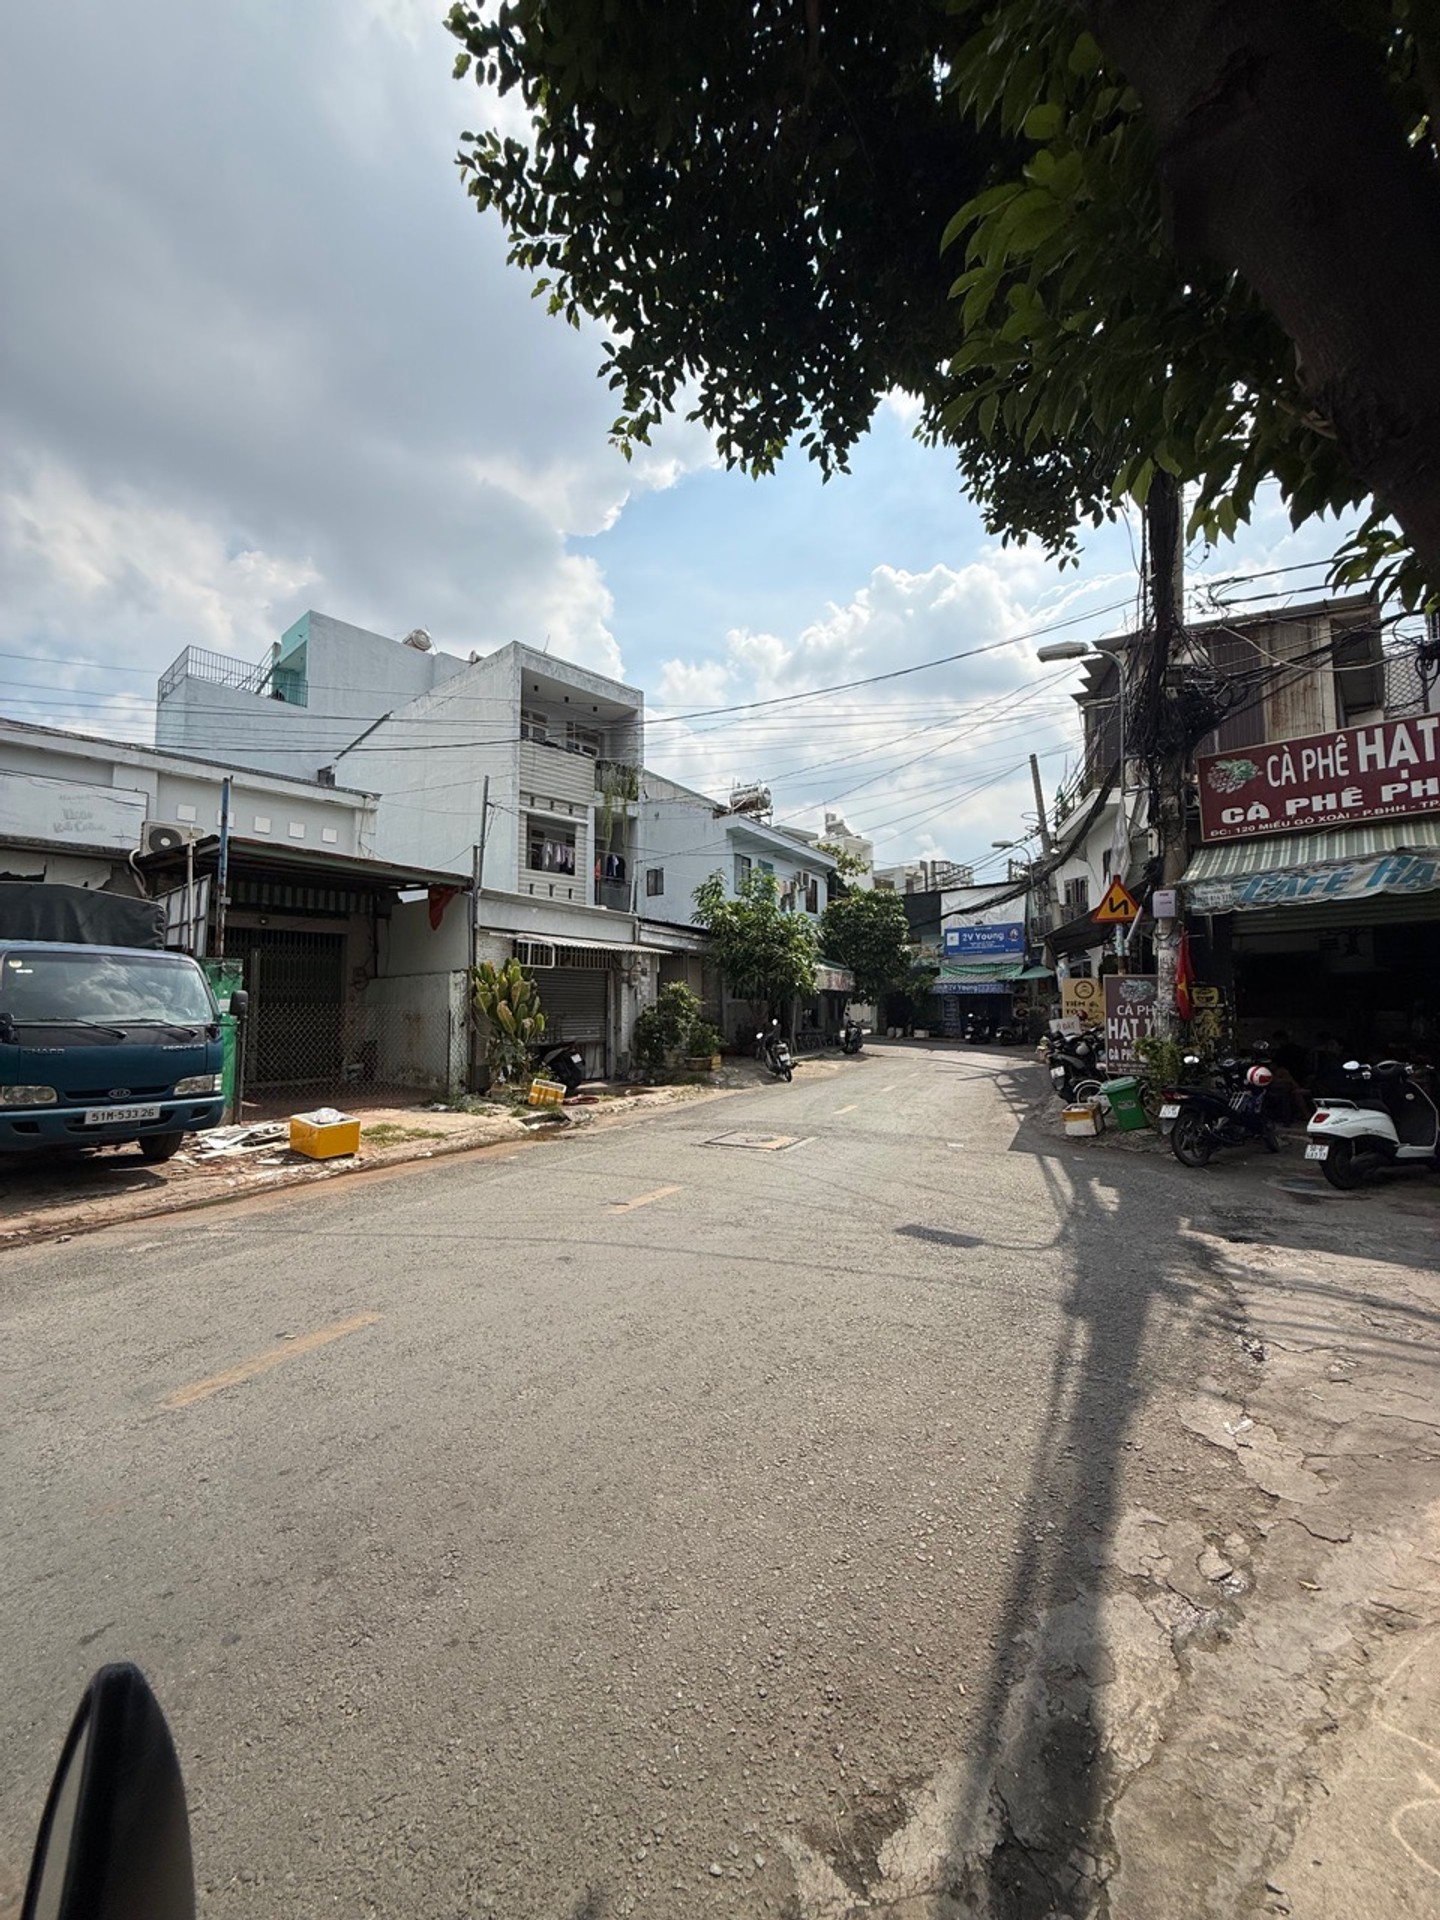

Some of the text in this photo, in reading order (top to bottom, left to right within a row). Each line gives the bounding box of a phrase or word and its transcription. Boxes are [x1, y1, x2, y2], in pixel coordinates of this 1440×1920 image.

[1267, 717, 1439, 787] CÀ PHÊ HẠT
[1221, 801, 1270, 824] CÀ
[1285, 786, 1363, 816] PHÊ
[1235, 825, 1255, 834] 120
[975, 932, 1005, 942] Young
[1117, 1002, 1133, 1016] CÀ
[1108, 1018, 1139, 1047] HẠT
[1109, 1046, 1120, 1060] CÀ
